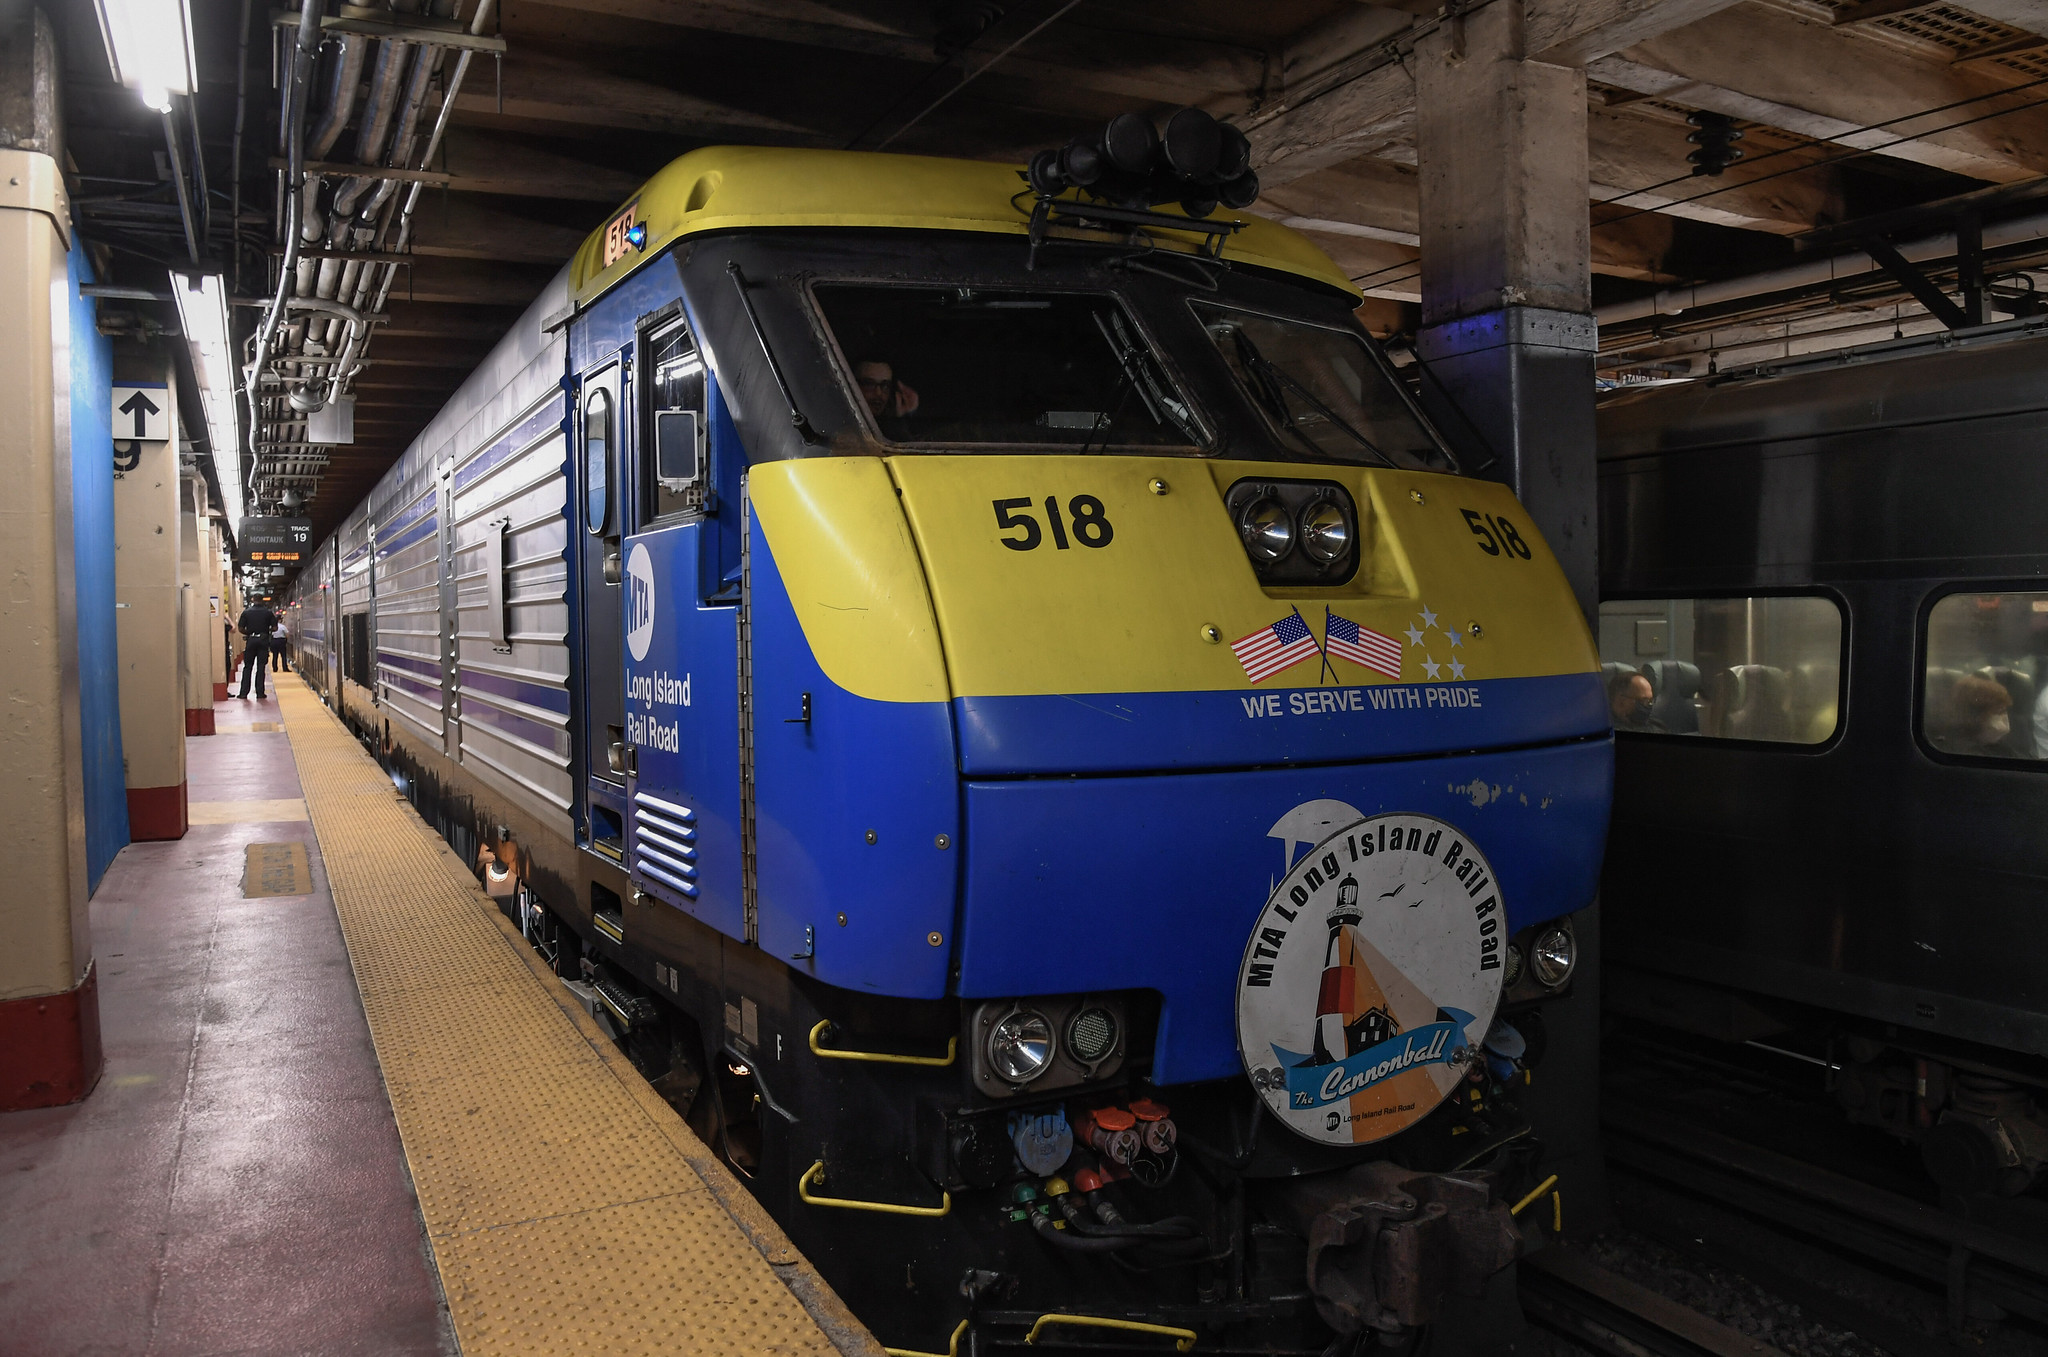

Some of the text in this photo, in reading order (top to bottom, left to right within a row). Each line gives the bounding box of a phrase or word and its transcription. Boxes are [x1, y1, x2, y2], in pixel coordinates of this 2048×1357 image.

[610, 213, 632, 254] 518
[250, 536, 284, 544] MONTAUK
[294, 533, 307, 543] 19
[992, 494, 1114, 551] 518
[1459, 508, 1532, 560] 518
[627, 572, 649, 635] MTA
[626, 668, 691, 710] Long Island
[1241, 688, 1482, 719] WE SERVE WITH PRIDE
[627, 712, 679, 754] Rail Road
[1246, 927, 1287, 987] MTA
[1273, 851, 1341, 923] Long
[1347, 824, 1443, 863] Island
[1442, 840, 1489, 898] Rail
[1475, 895, 1501, 971] Road
[776, 1033, 783, 1061] F
[1295, 1029, 1450, 1106] The Cannonball
[1343, 1114, 1361, 1123] Long
[1362, 1108, 1383, 1120] Island
[1383, 1105, 1397, 1115] Rail
[1398, 1103, 1416, 1112] Road
